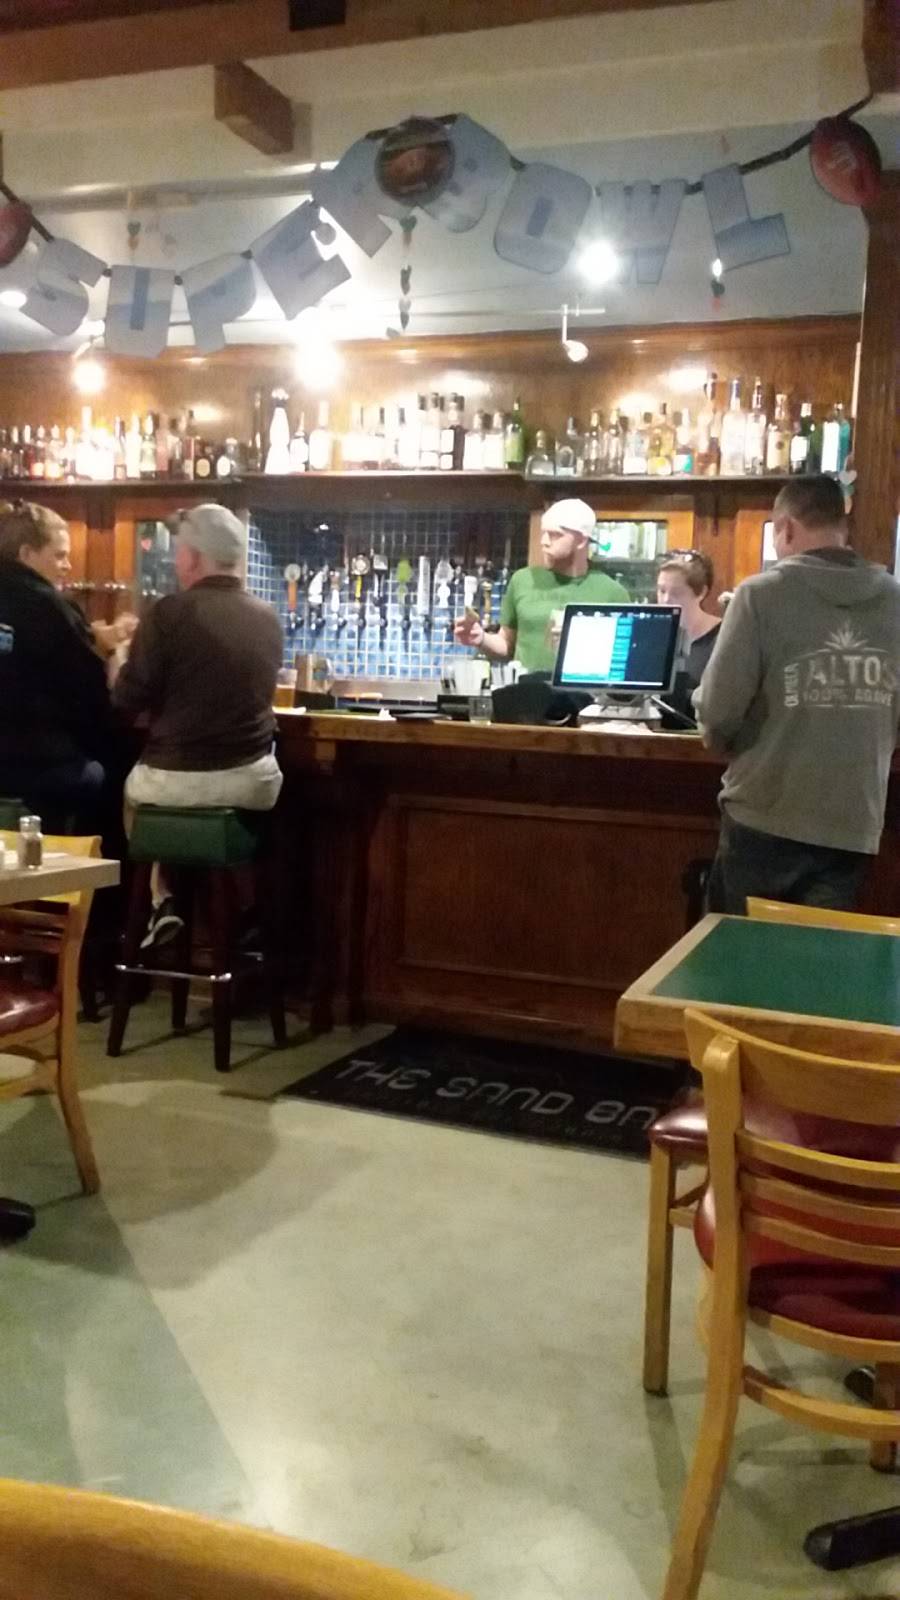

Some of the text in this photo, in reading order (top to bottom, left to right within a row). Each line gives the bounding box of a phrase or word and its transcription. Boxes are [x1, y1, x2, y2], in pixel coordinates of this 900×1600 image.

[334, 1060, 431, 1089] THE
[436, 1078, 574, 1114] SAND
[584, 1101, 659, 1129] BA
